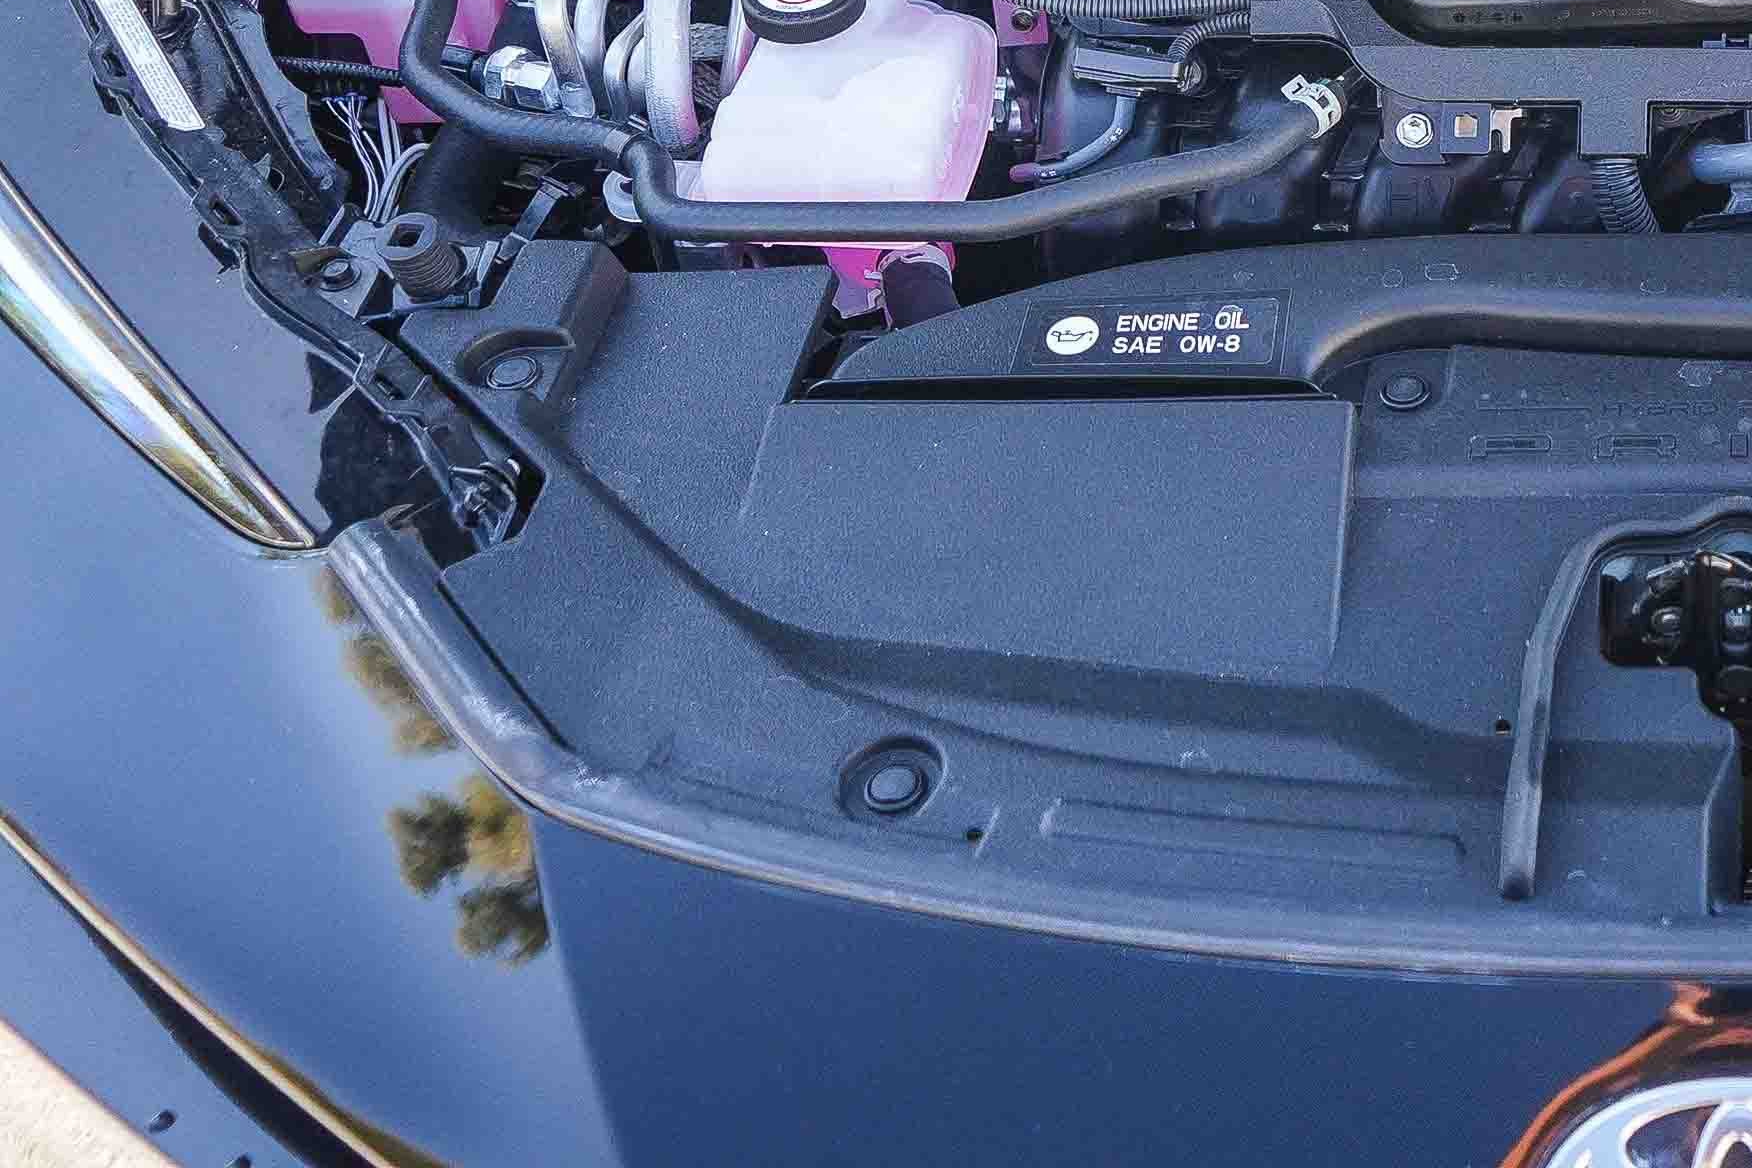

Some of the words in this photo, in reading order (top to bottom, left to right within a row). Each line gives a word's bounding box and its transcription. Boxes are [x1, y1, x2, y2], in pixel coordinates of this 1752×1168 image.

[1116, 312, 1200, 333] ENGINE
[1214, 311, 1250, 330] OIL
[1112, 335, 1163, 354] SAE
[1601, 400, 1719, 417] HYBRID
